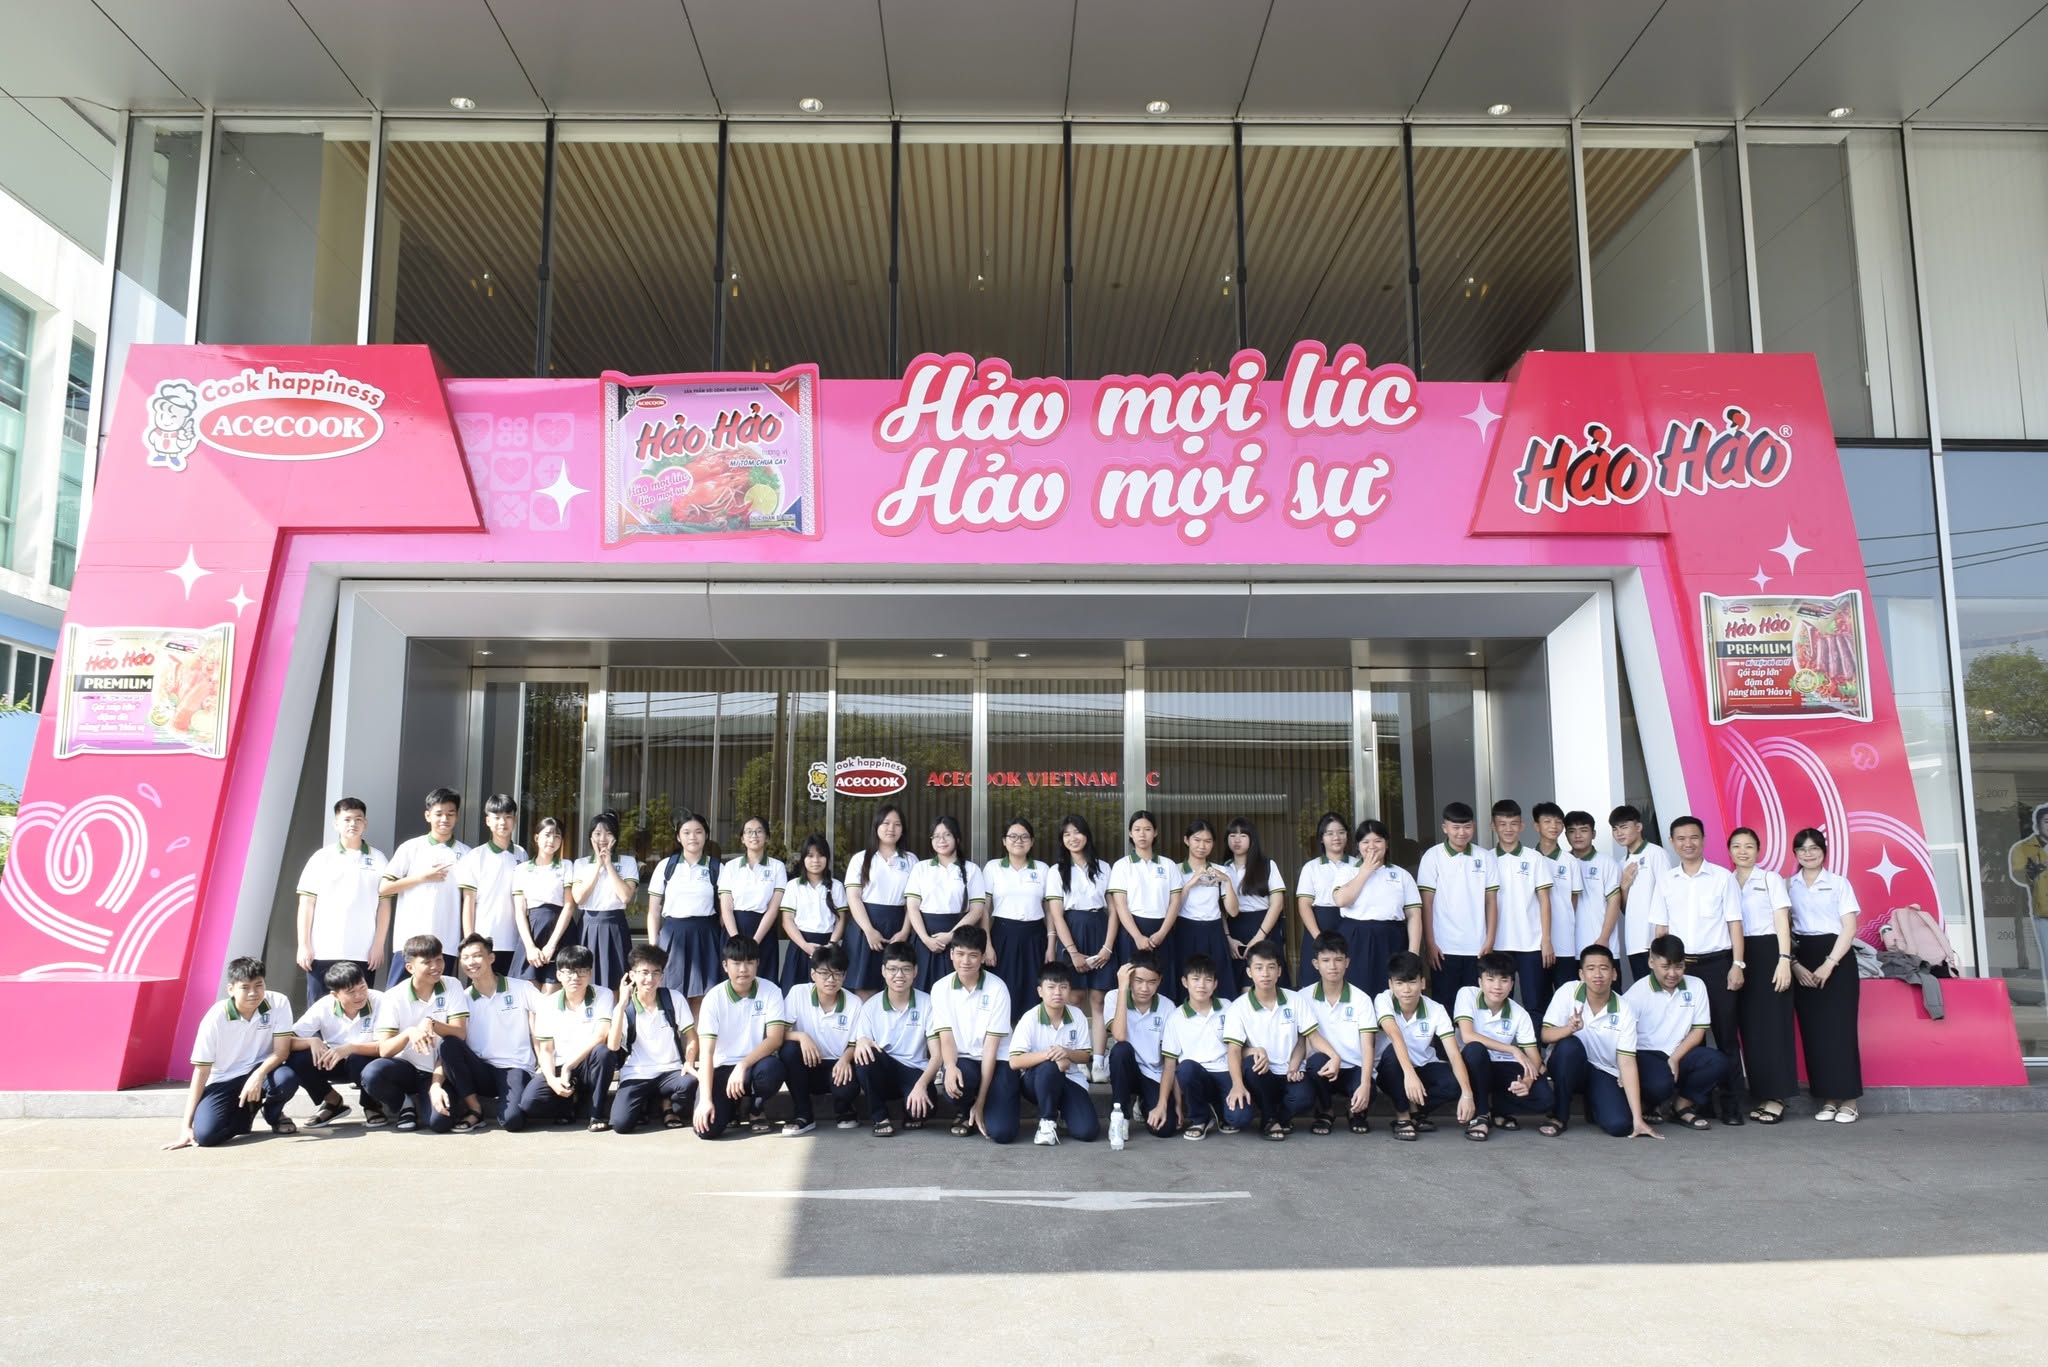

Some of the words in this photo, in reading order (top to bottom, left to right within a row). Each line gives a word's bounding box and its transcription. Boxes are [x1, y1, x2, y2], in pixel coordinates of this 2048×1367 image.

[202, 373, 260, 402] Cook
[267, 371, 381, 407] happiness
[880, 364, 1064, 443] Hảo
[1098, 361, 1261, 455] mọi
[1287, 353, 1416, 429] lúc
[636, 414, 706, 460] Hảo
[711, 403, 783, 448] Hảo
[1516, 424, 1649, 511] Hảo
[1657, 408, 1788, 493] Hảo
[877, 446, 1065, 528] Hảo
[1098, 443, 1265, 538] mọi
[1289, 458, 1390, 539] sự
[1725, 617, 1757, 639] Hảo
[1759, 613, 1791, 634] Hảo
[1727, 643, 1791, 655] PREMIUM
[84, 678, 153, 690] PREMIUM
[835, 759, 854, 771] ook
[857, 759, 905, 773] happiness
[1026, 771, 1118, 786] VIETNAM
[1986, 790, 2009, 798] 2007
[1997, 931, 2016, 940] 200
